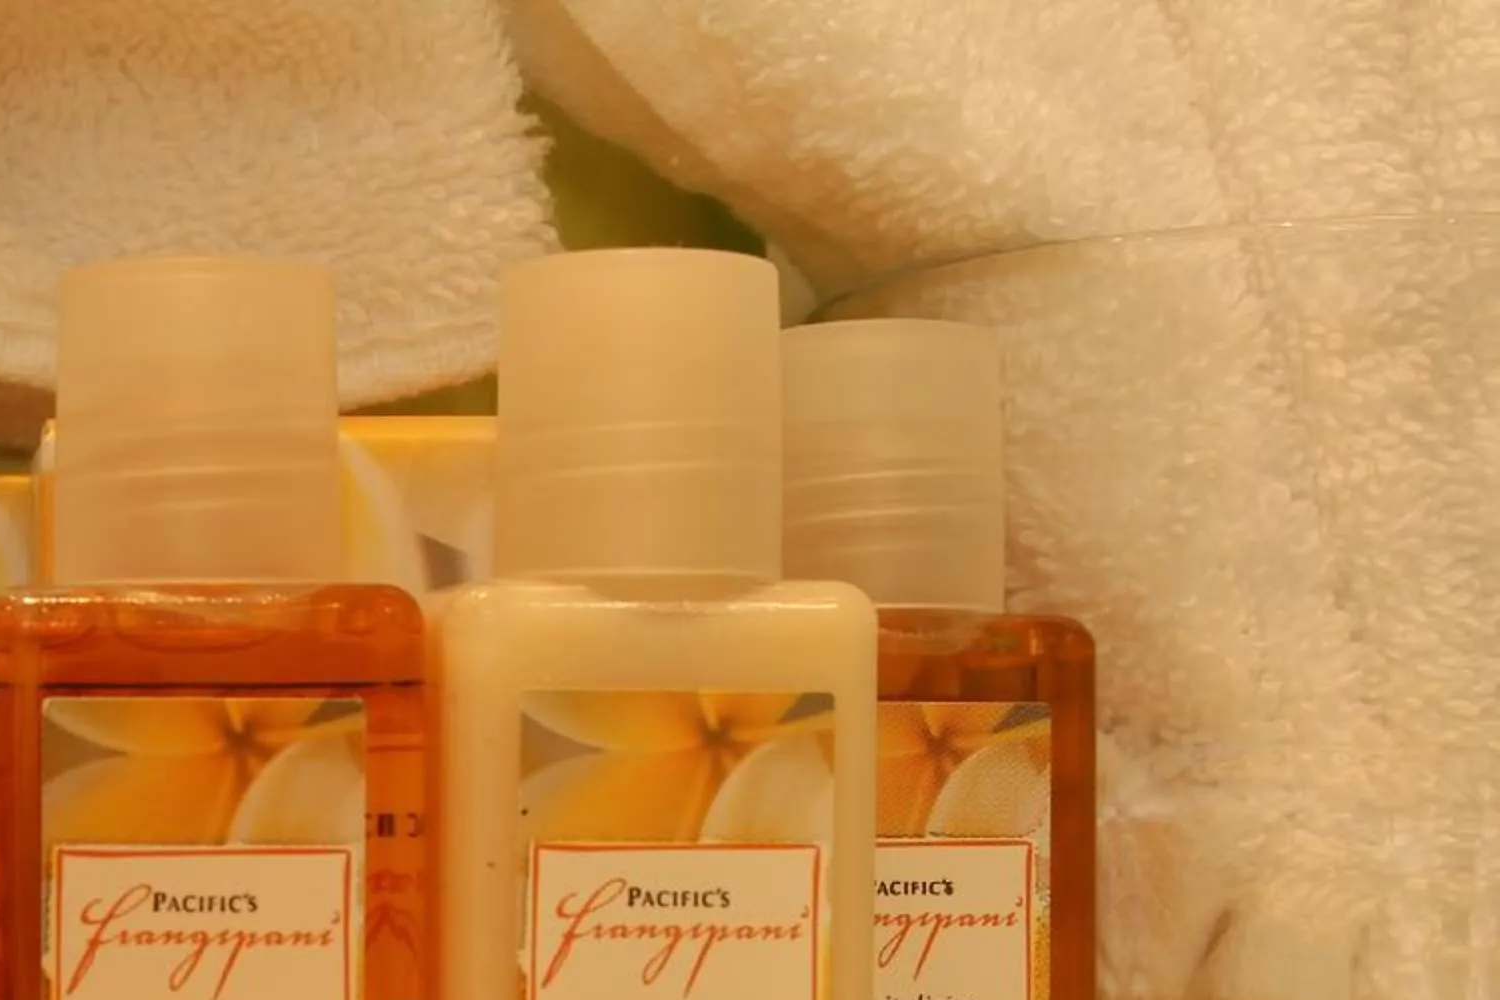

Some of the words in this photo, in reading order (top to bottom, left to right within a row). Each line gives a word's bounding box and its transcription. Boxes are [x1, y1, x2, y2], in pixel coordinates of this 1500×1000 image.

[626, 887, 731, 909] PACIFIC'S
[875, 878, 954, 897] ACIFIC'S
[151, 891, 258, 914] PACIFIC'S
